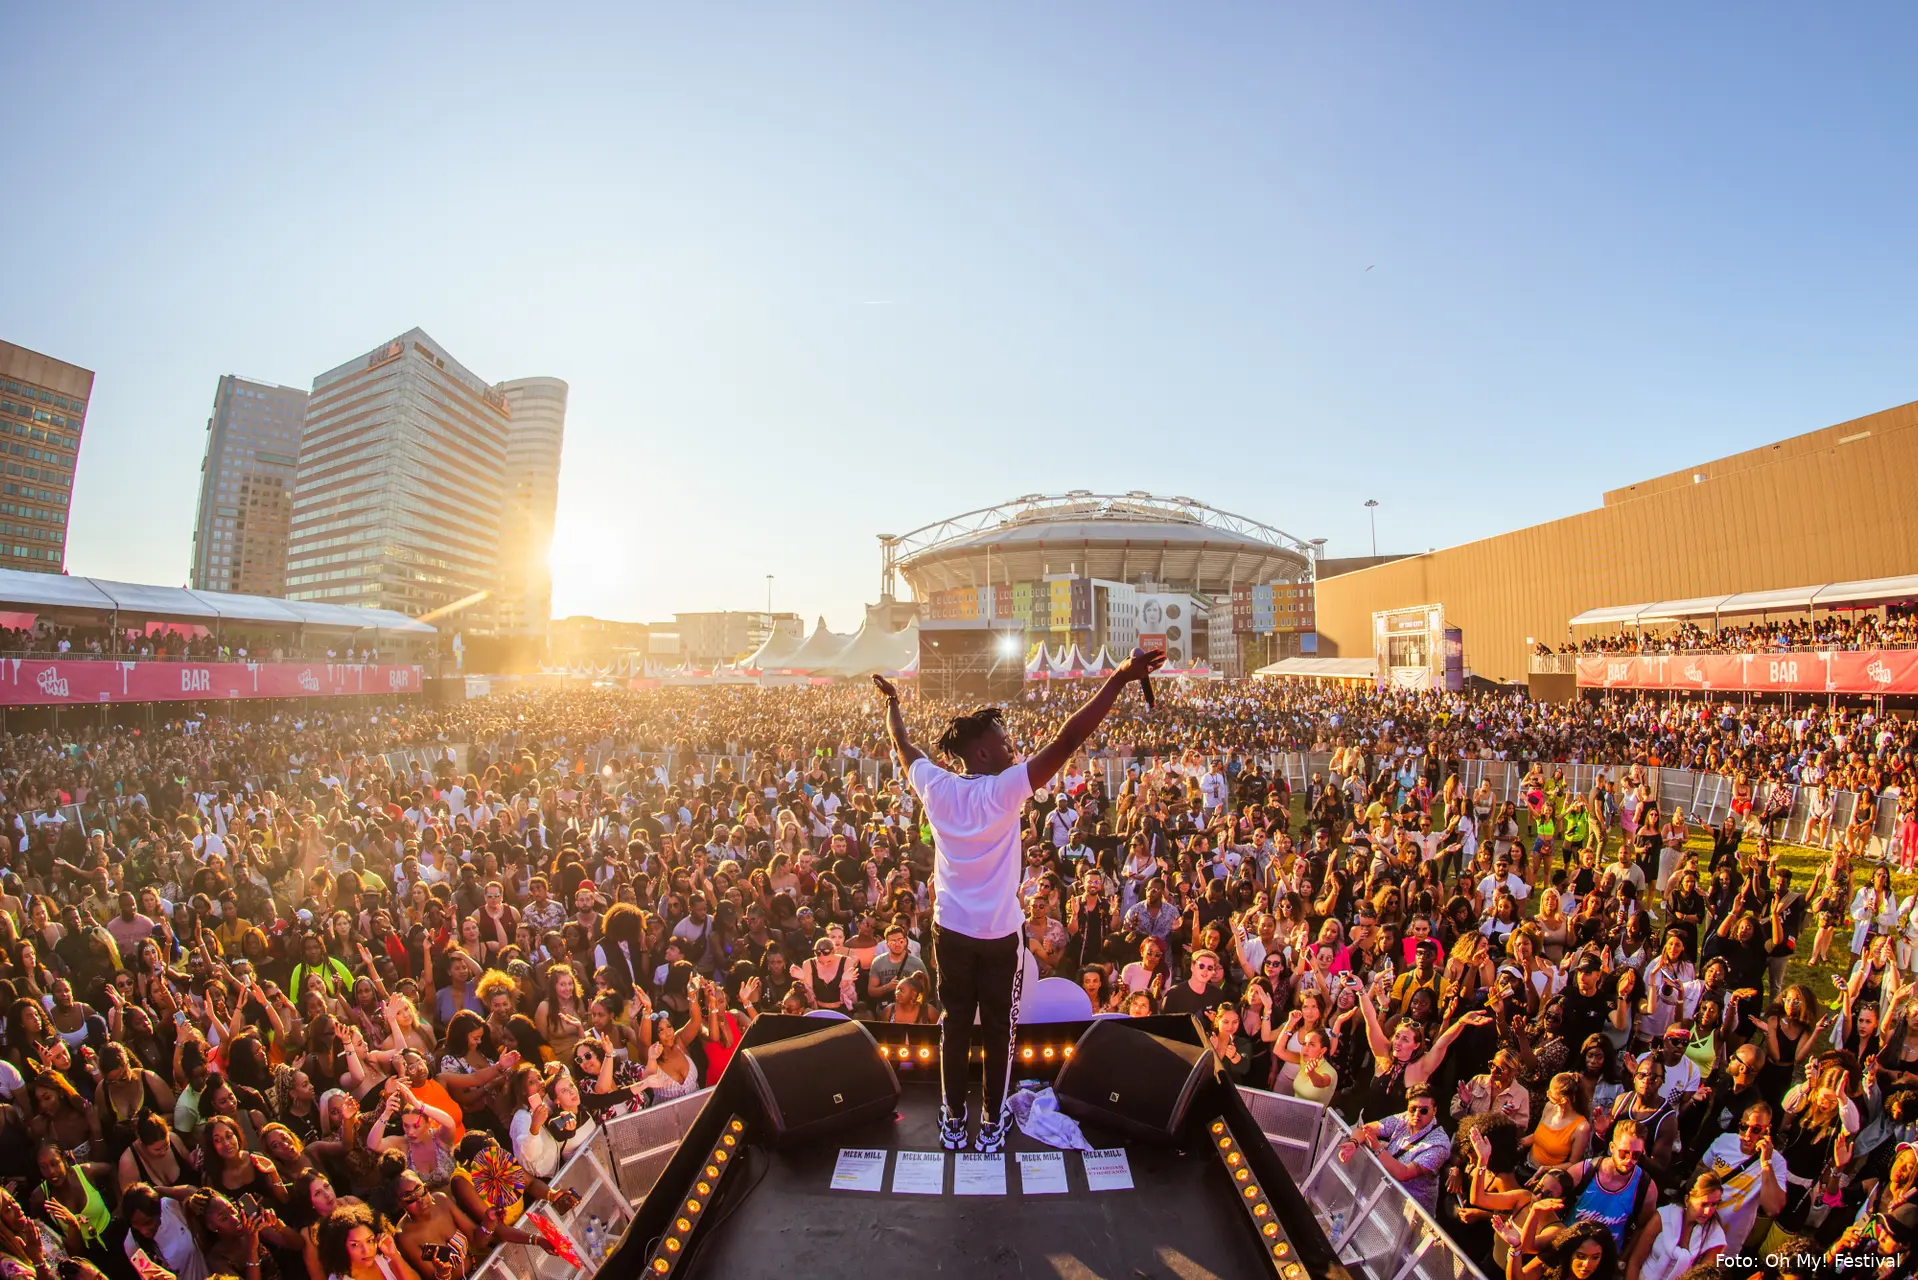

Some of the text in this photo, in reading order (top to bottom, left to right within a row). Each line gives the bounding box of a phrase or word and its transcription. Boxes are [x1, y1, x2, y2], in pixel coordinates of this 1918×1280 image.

[37, 666, 57, 686] OH
[389, 670, 408, 687] BAR
[1607, 663, 1628, 681] BAR
[1769, 661, 1798, 682] BAR
[45, 678, 69, 697] MY!
[181, 669, 210, 692] BAR
[843, 1150, 882, 1160] MEEK MILL
[902, 1152, 942, 1162] MEEK MILL
[962, 1153, 1002, 1161] MEEK MILL
[1021, 1153, 1061, 1162] MEEK MILL
[1083, 1149, 1122, 1159] MEEK MILL
